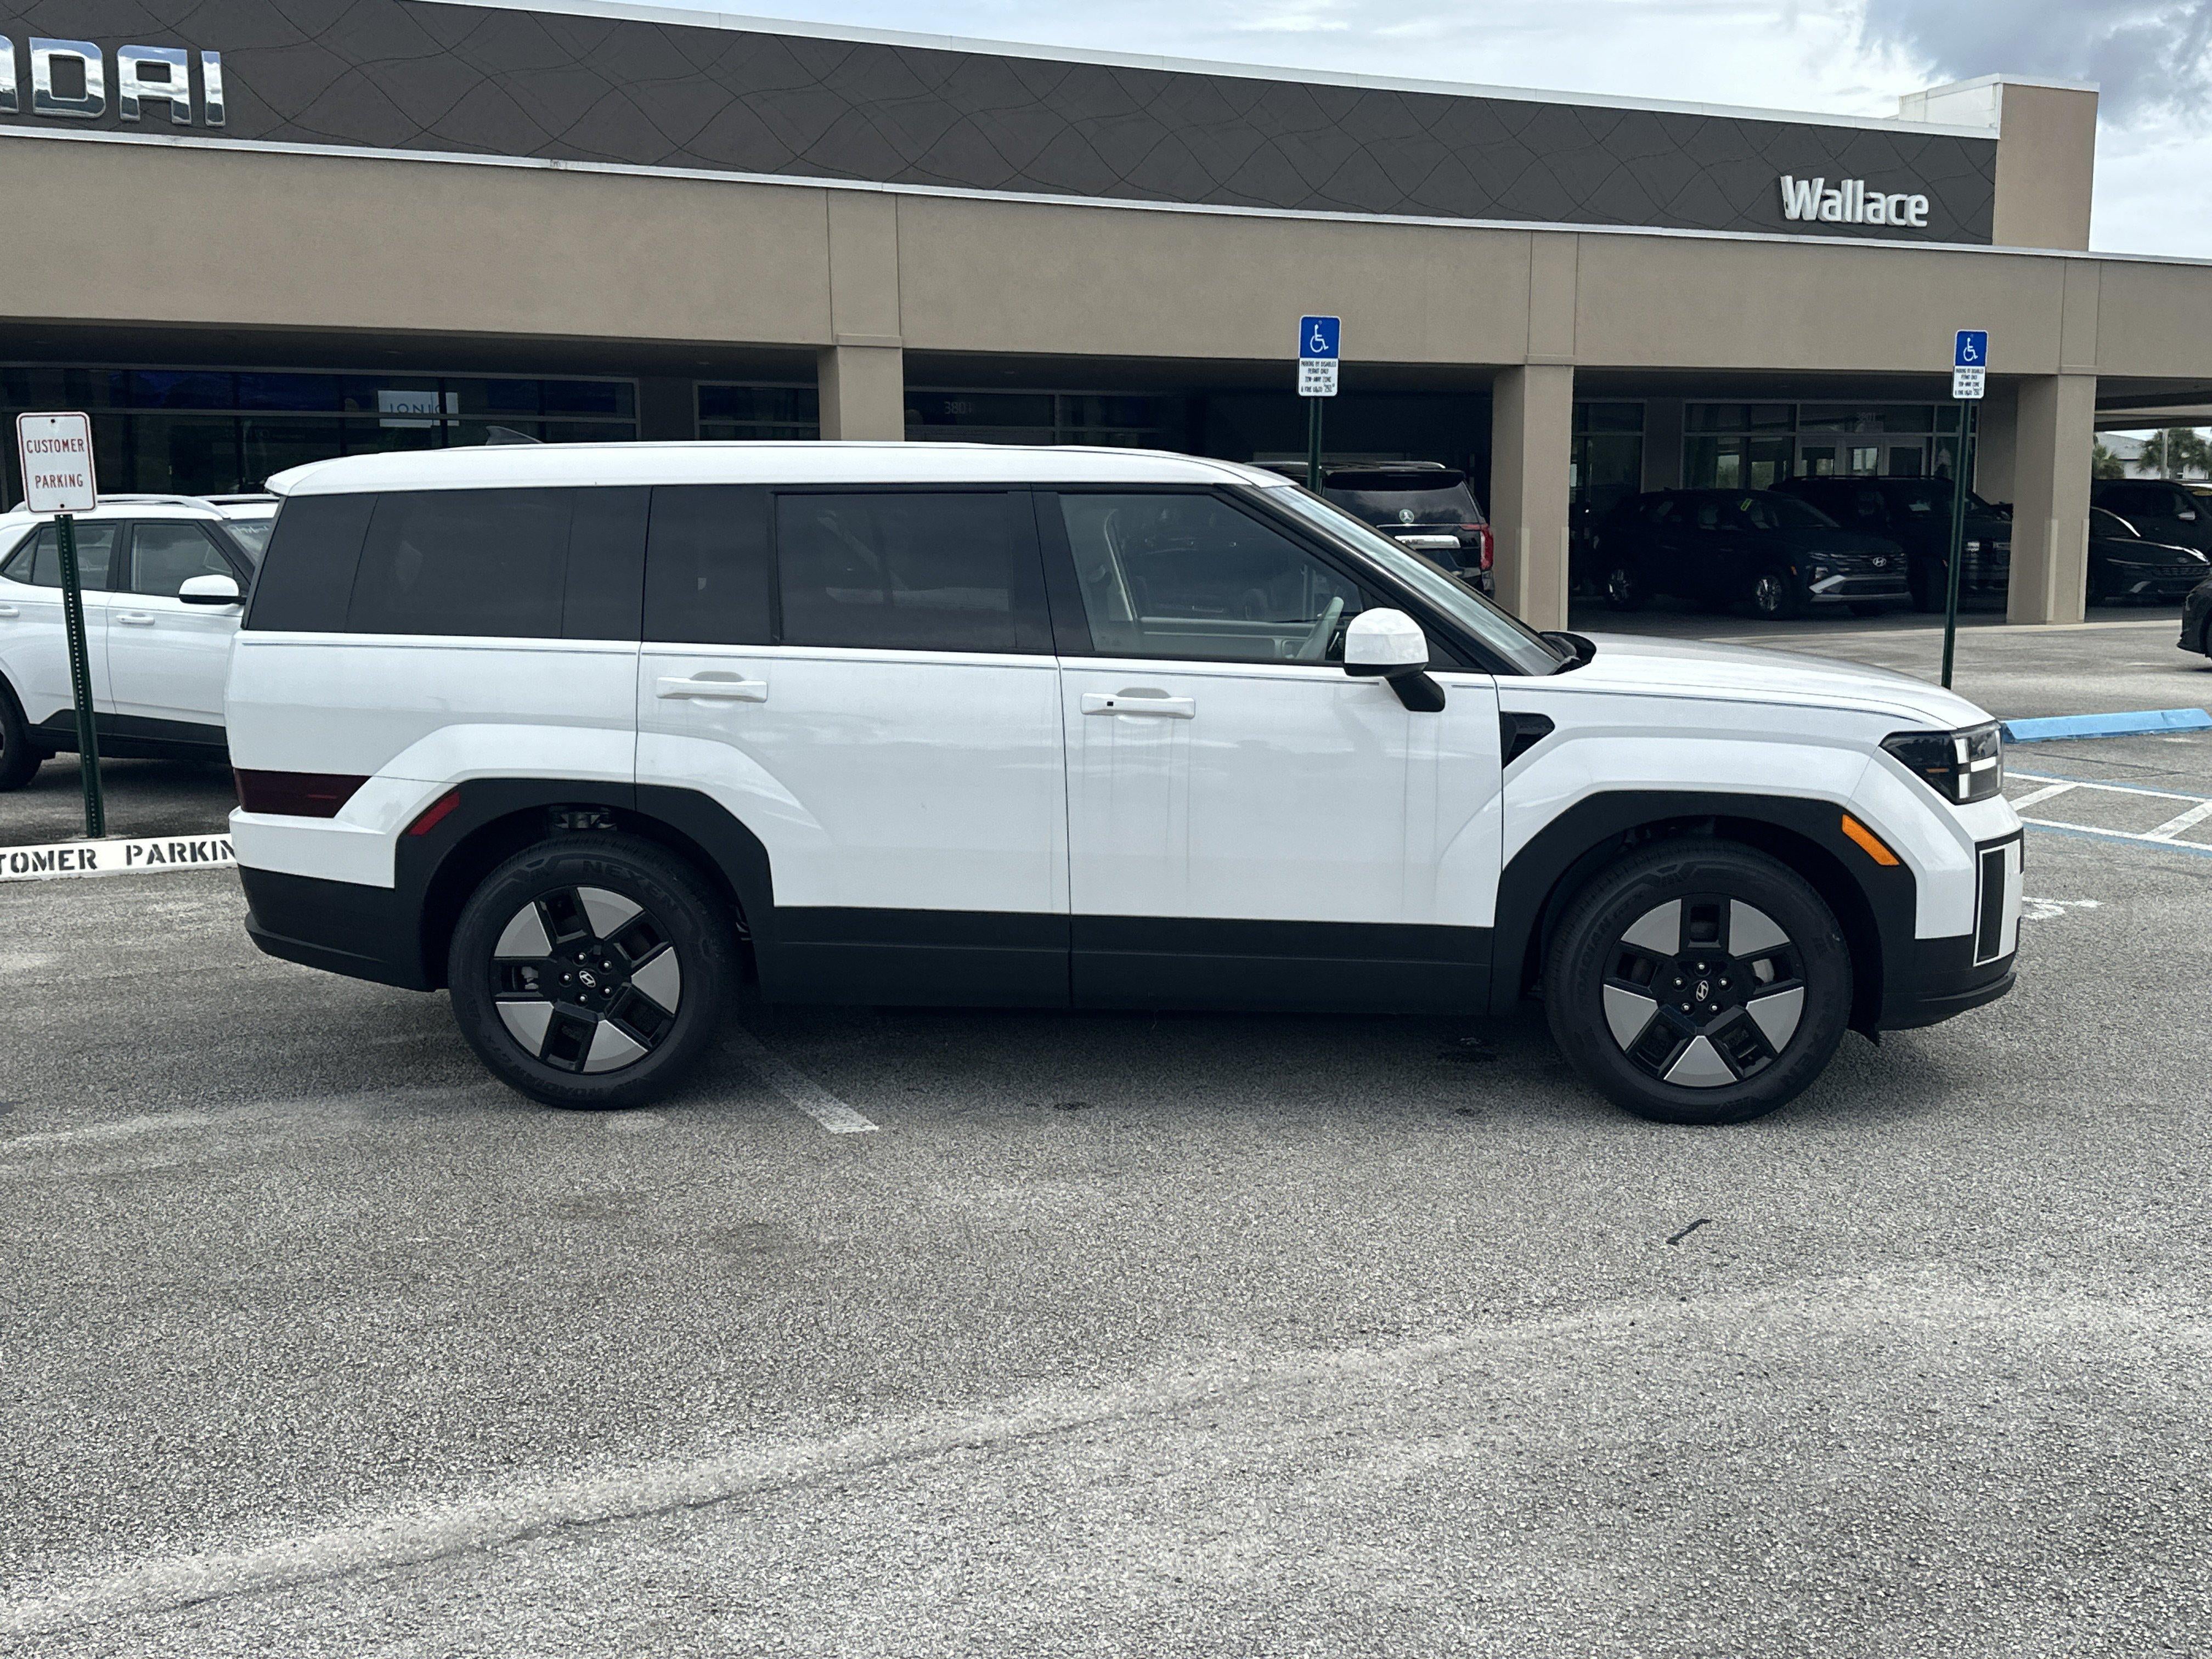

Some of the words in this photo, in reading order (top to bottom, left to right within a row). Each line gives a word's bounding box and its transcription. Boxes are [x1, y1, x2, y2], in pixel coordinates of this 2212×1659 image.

[1780, 175, 1929, 227] Wallace
[26, 439, 84, 454] CUSTOMER
[35, 473, 83, 489] PARKING
